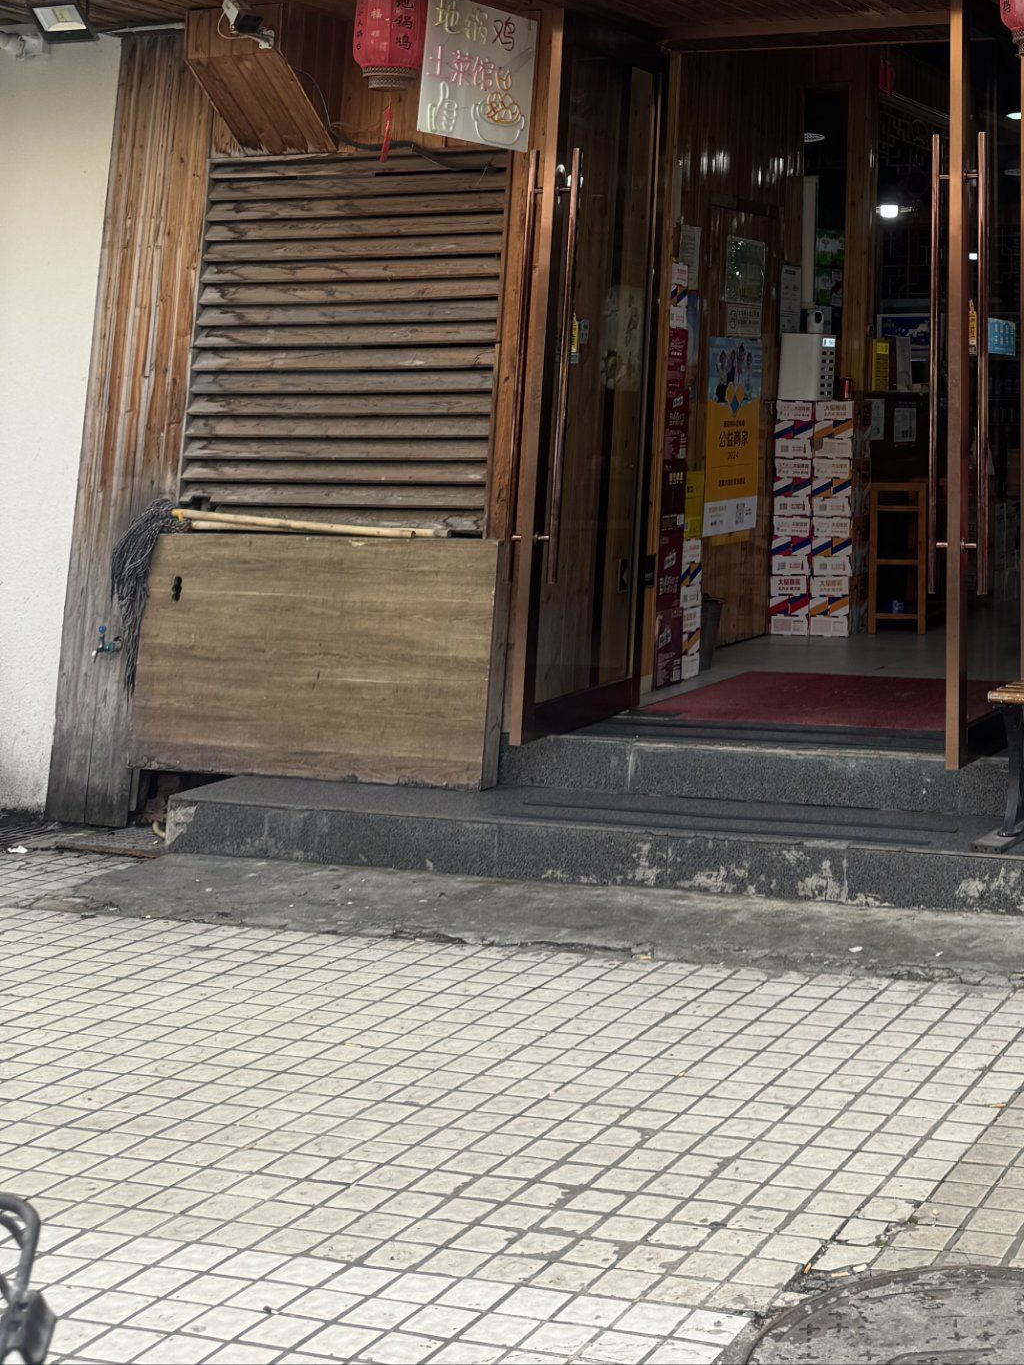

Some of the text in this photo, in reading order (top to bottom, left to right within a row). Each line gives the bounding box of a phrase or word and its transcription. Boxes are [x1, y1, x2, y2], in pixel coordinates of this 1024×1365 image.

[426, 45, 494, 90] 土菜馆
[718, 430, 749, 448] 公益商家
